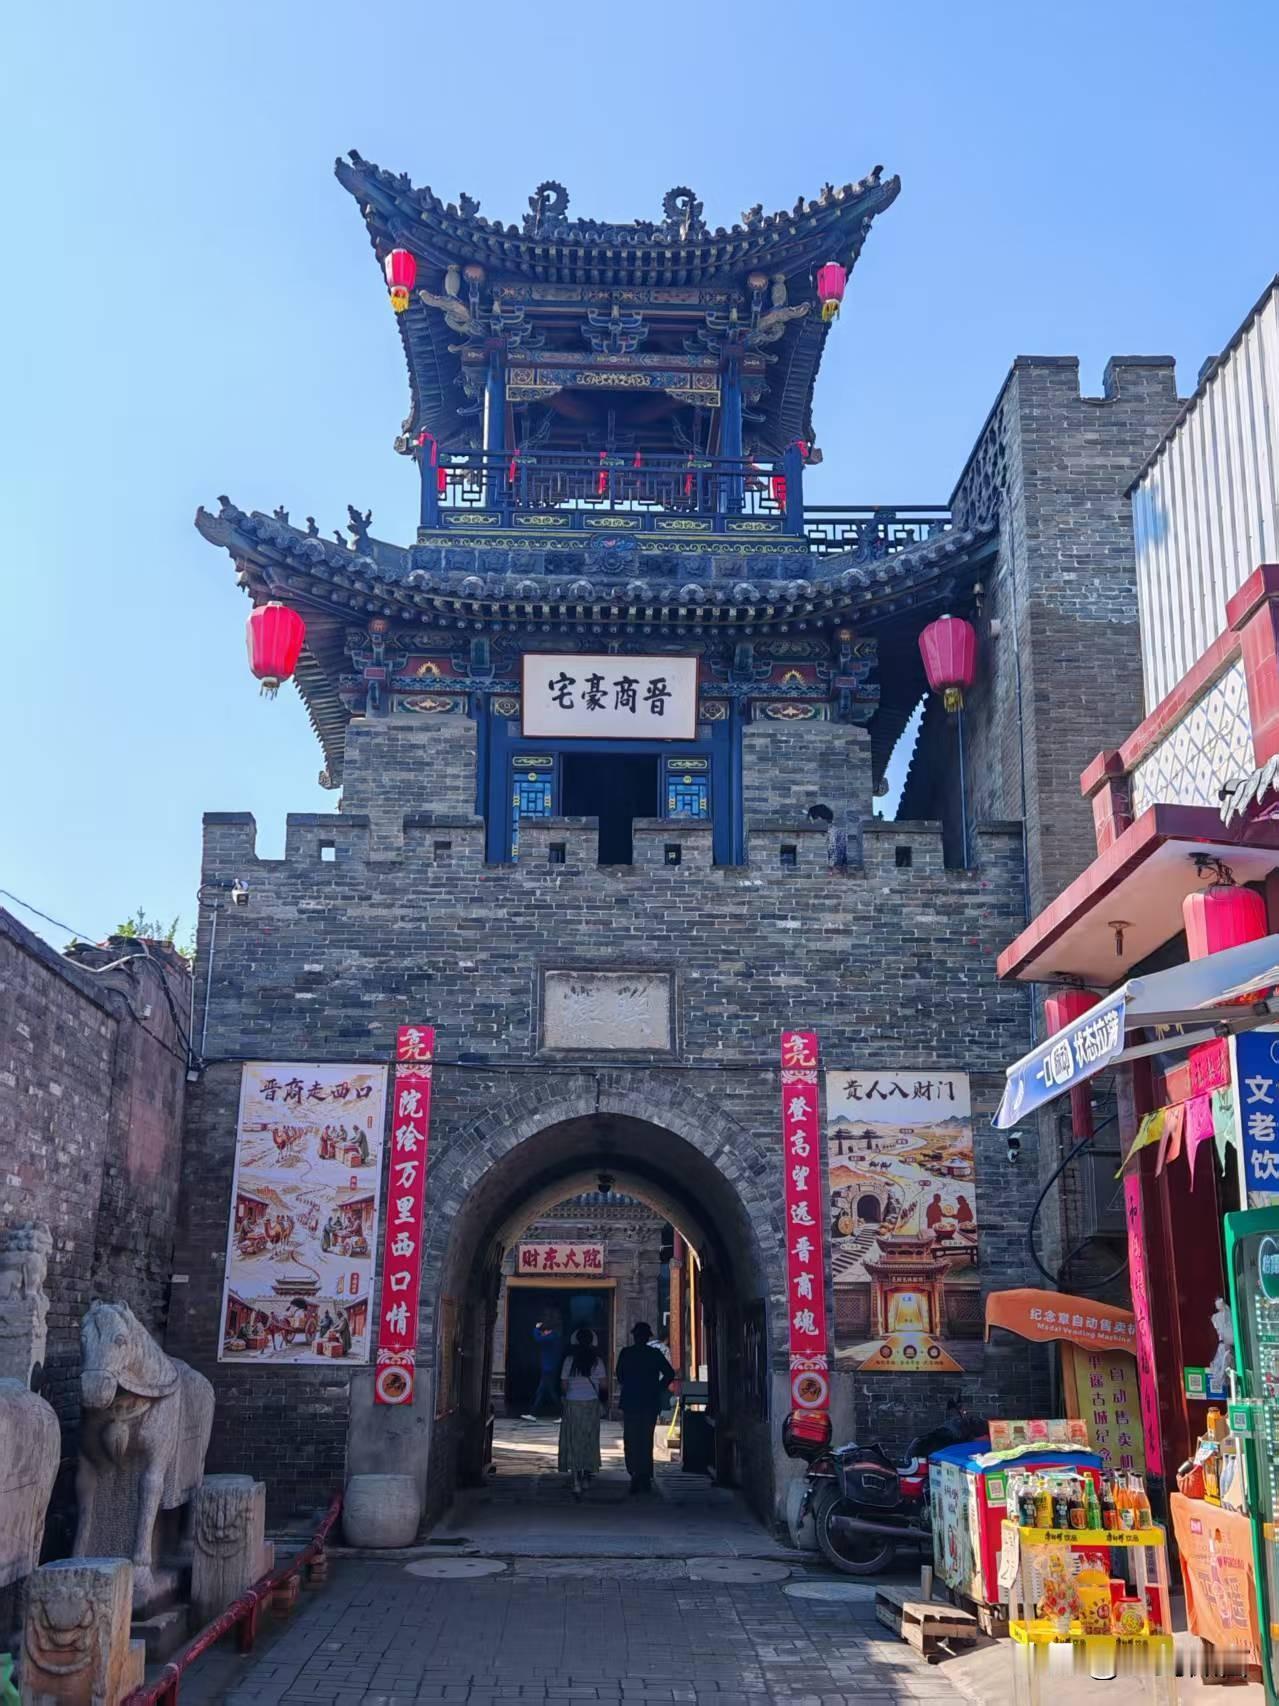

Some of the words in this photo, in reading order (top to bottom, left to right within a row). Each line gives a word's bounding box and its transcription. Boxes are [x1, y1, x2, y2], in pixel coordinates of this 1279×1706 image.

[260, 1077, 373, 1104] 晋商走西口
